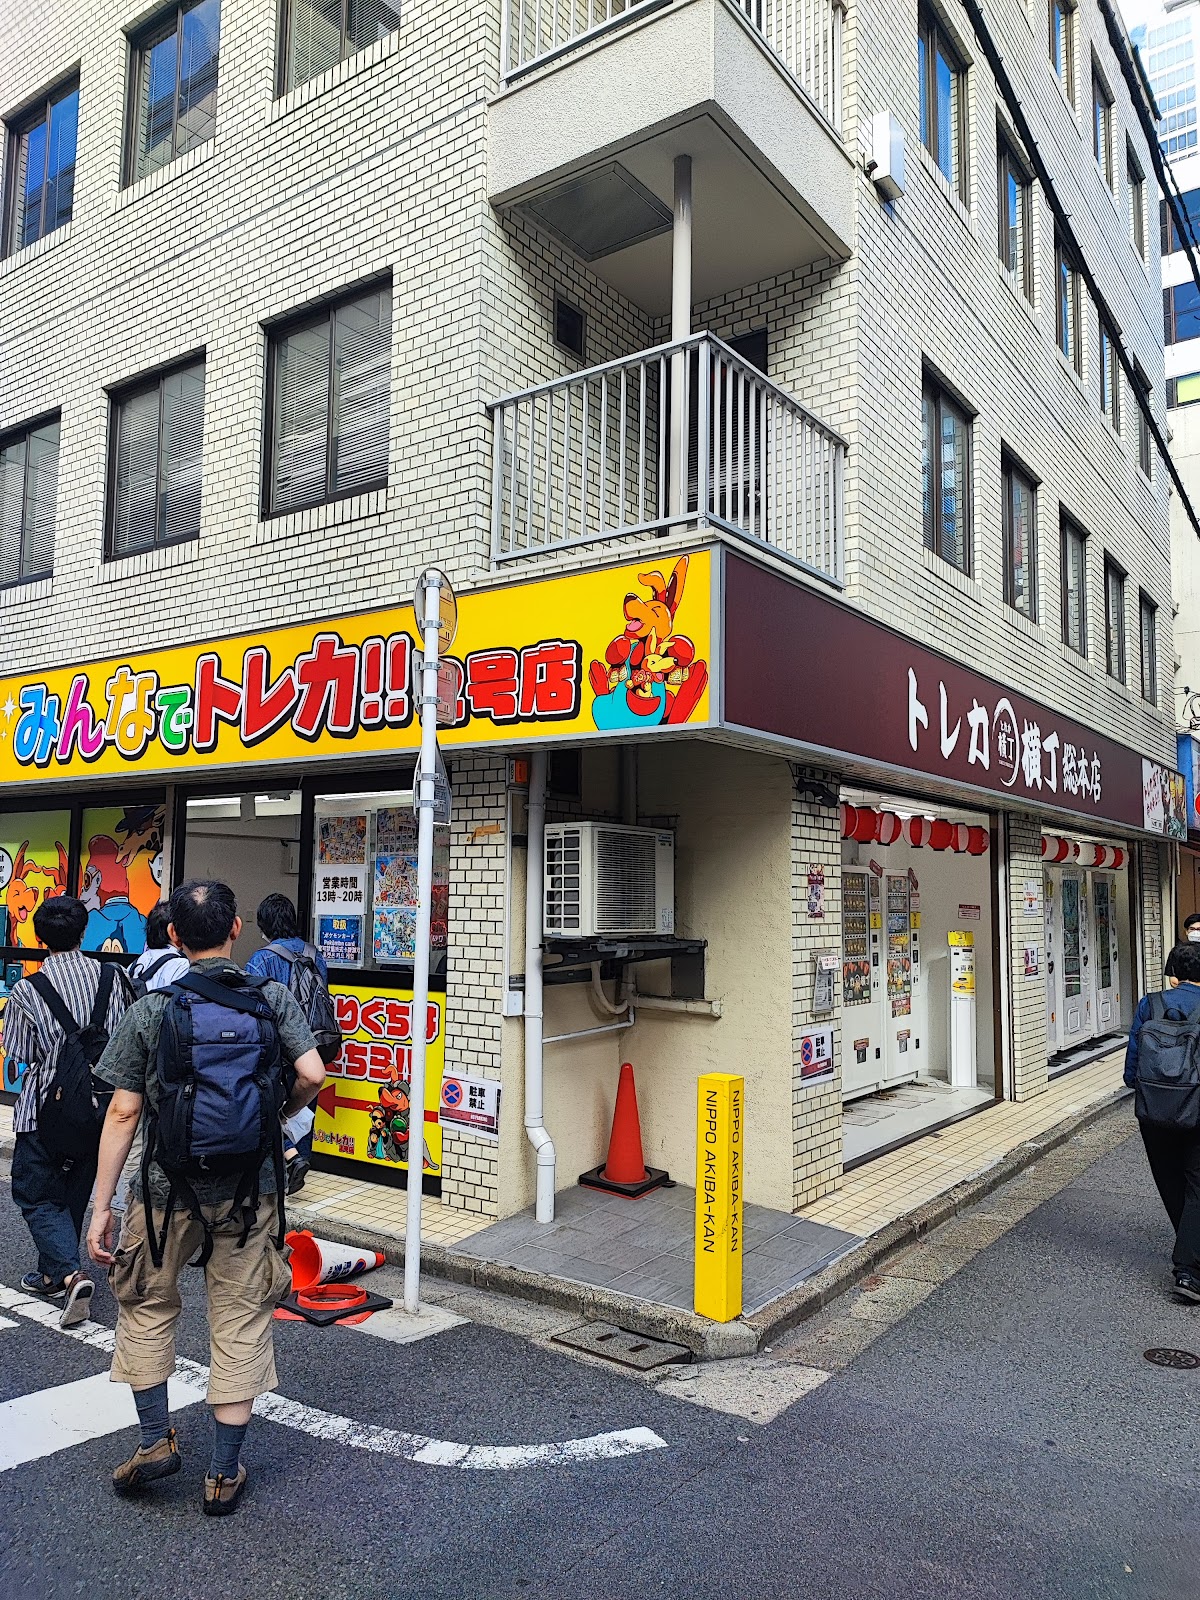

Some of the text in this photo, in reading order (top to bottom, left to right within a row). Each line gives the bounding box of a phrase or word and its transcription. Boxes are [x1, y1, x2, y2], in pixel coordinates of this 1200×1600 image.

[425, 638, 583, 729] 号店
[907, 666, 990, 771] トレカ
[1021, 718, 1060, 793] 横丁
[1062, 742, 1102, 804] 総本店
[322, 876, 358, 889] 営業時間
[468, 1097, 485, 1110] 禁止
[469, 1085, 486, 1098] 駐車
[703, 1090, 717, 1253] NIPPO AKIBA-KAN
[731, 1090, 740, 1253] NIPPO AKIBA-KAN
